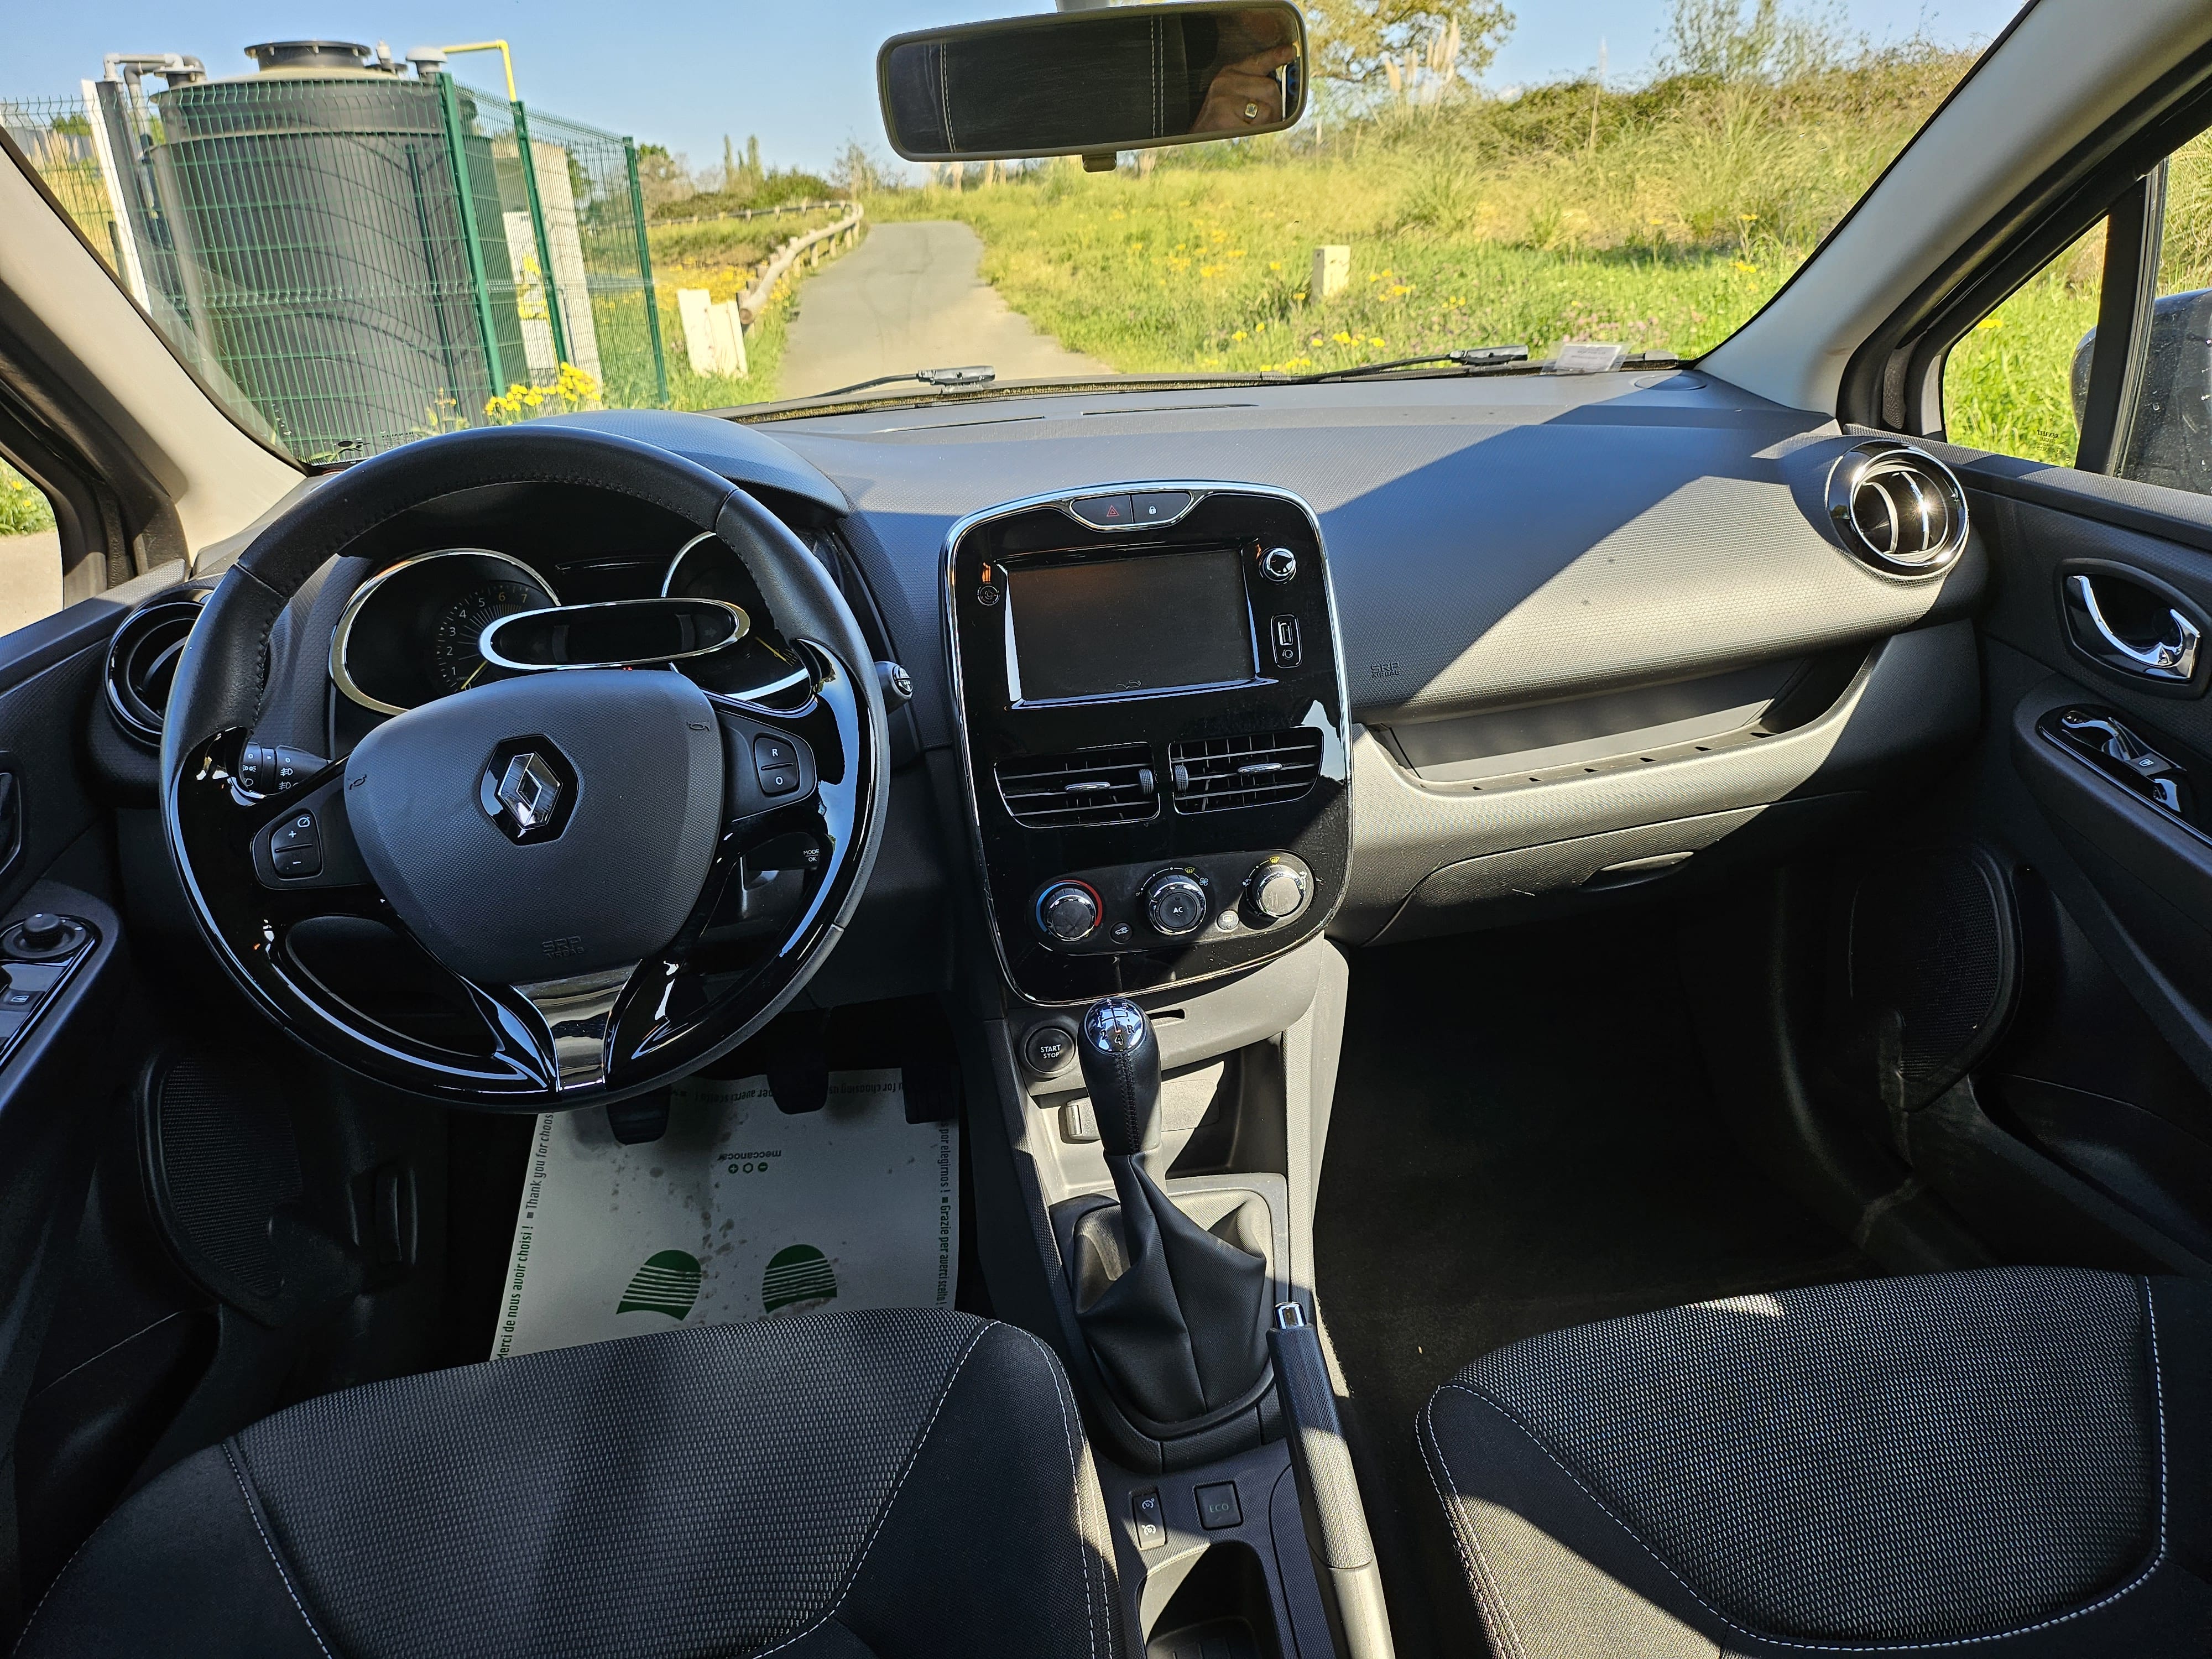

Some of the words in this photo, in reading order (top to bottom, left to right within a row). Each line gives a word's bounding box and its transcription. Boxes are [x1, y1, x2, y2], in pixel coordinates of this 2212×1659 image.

[499, 592, 505, 601] 6
[521, 594, 527, 603] 7
[478, 598, 485, 607] 5
[459, 609, 467, 618] 4
[450, 627, 456, 637] 3
[446, 646, 453, 655] 2
[452, 666, 456, 675] 1
[771, 748, 779, 757] R
[1126, 1025, 1136, 1035] R
[1114, 1034, 1124, 1045] 4
[1040, 1044, 1061, 1053] START
[883, 1083, 896, 1093] for
[539, 1114, 554, 1142] choos
[938, 1129, 949, 1144] por
[535, 1143, 549, 1157] for
[534, 1160, 546, 1178] you
[937, 1145, 951, 1187] elegirnos
[525, 1180, 542, 1209] Thank
[940, 1205, 951, 1235] Grazie
[517, 1232, 532, 1261] choisi
[938, 1237, 949, 1253] per
[508, 1293, 521, 1317] nous
[503, 1320, 516, 1332] de
[1209, 1503, 1229, 1513] ECO
